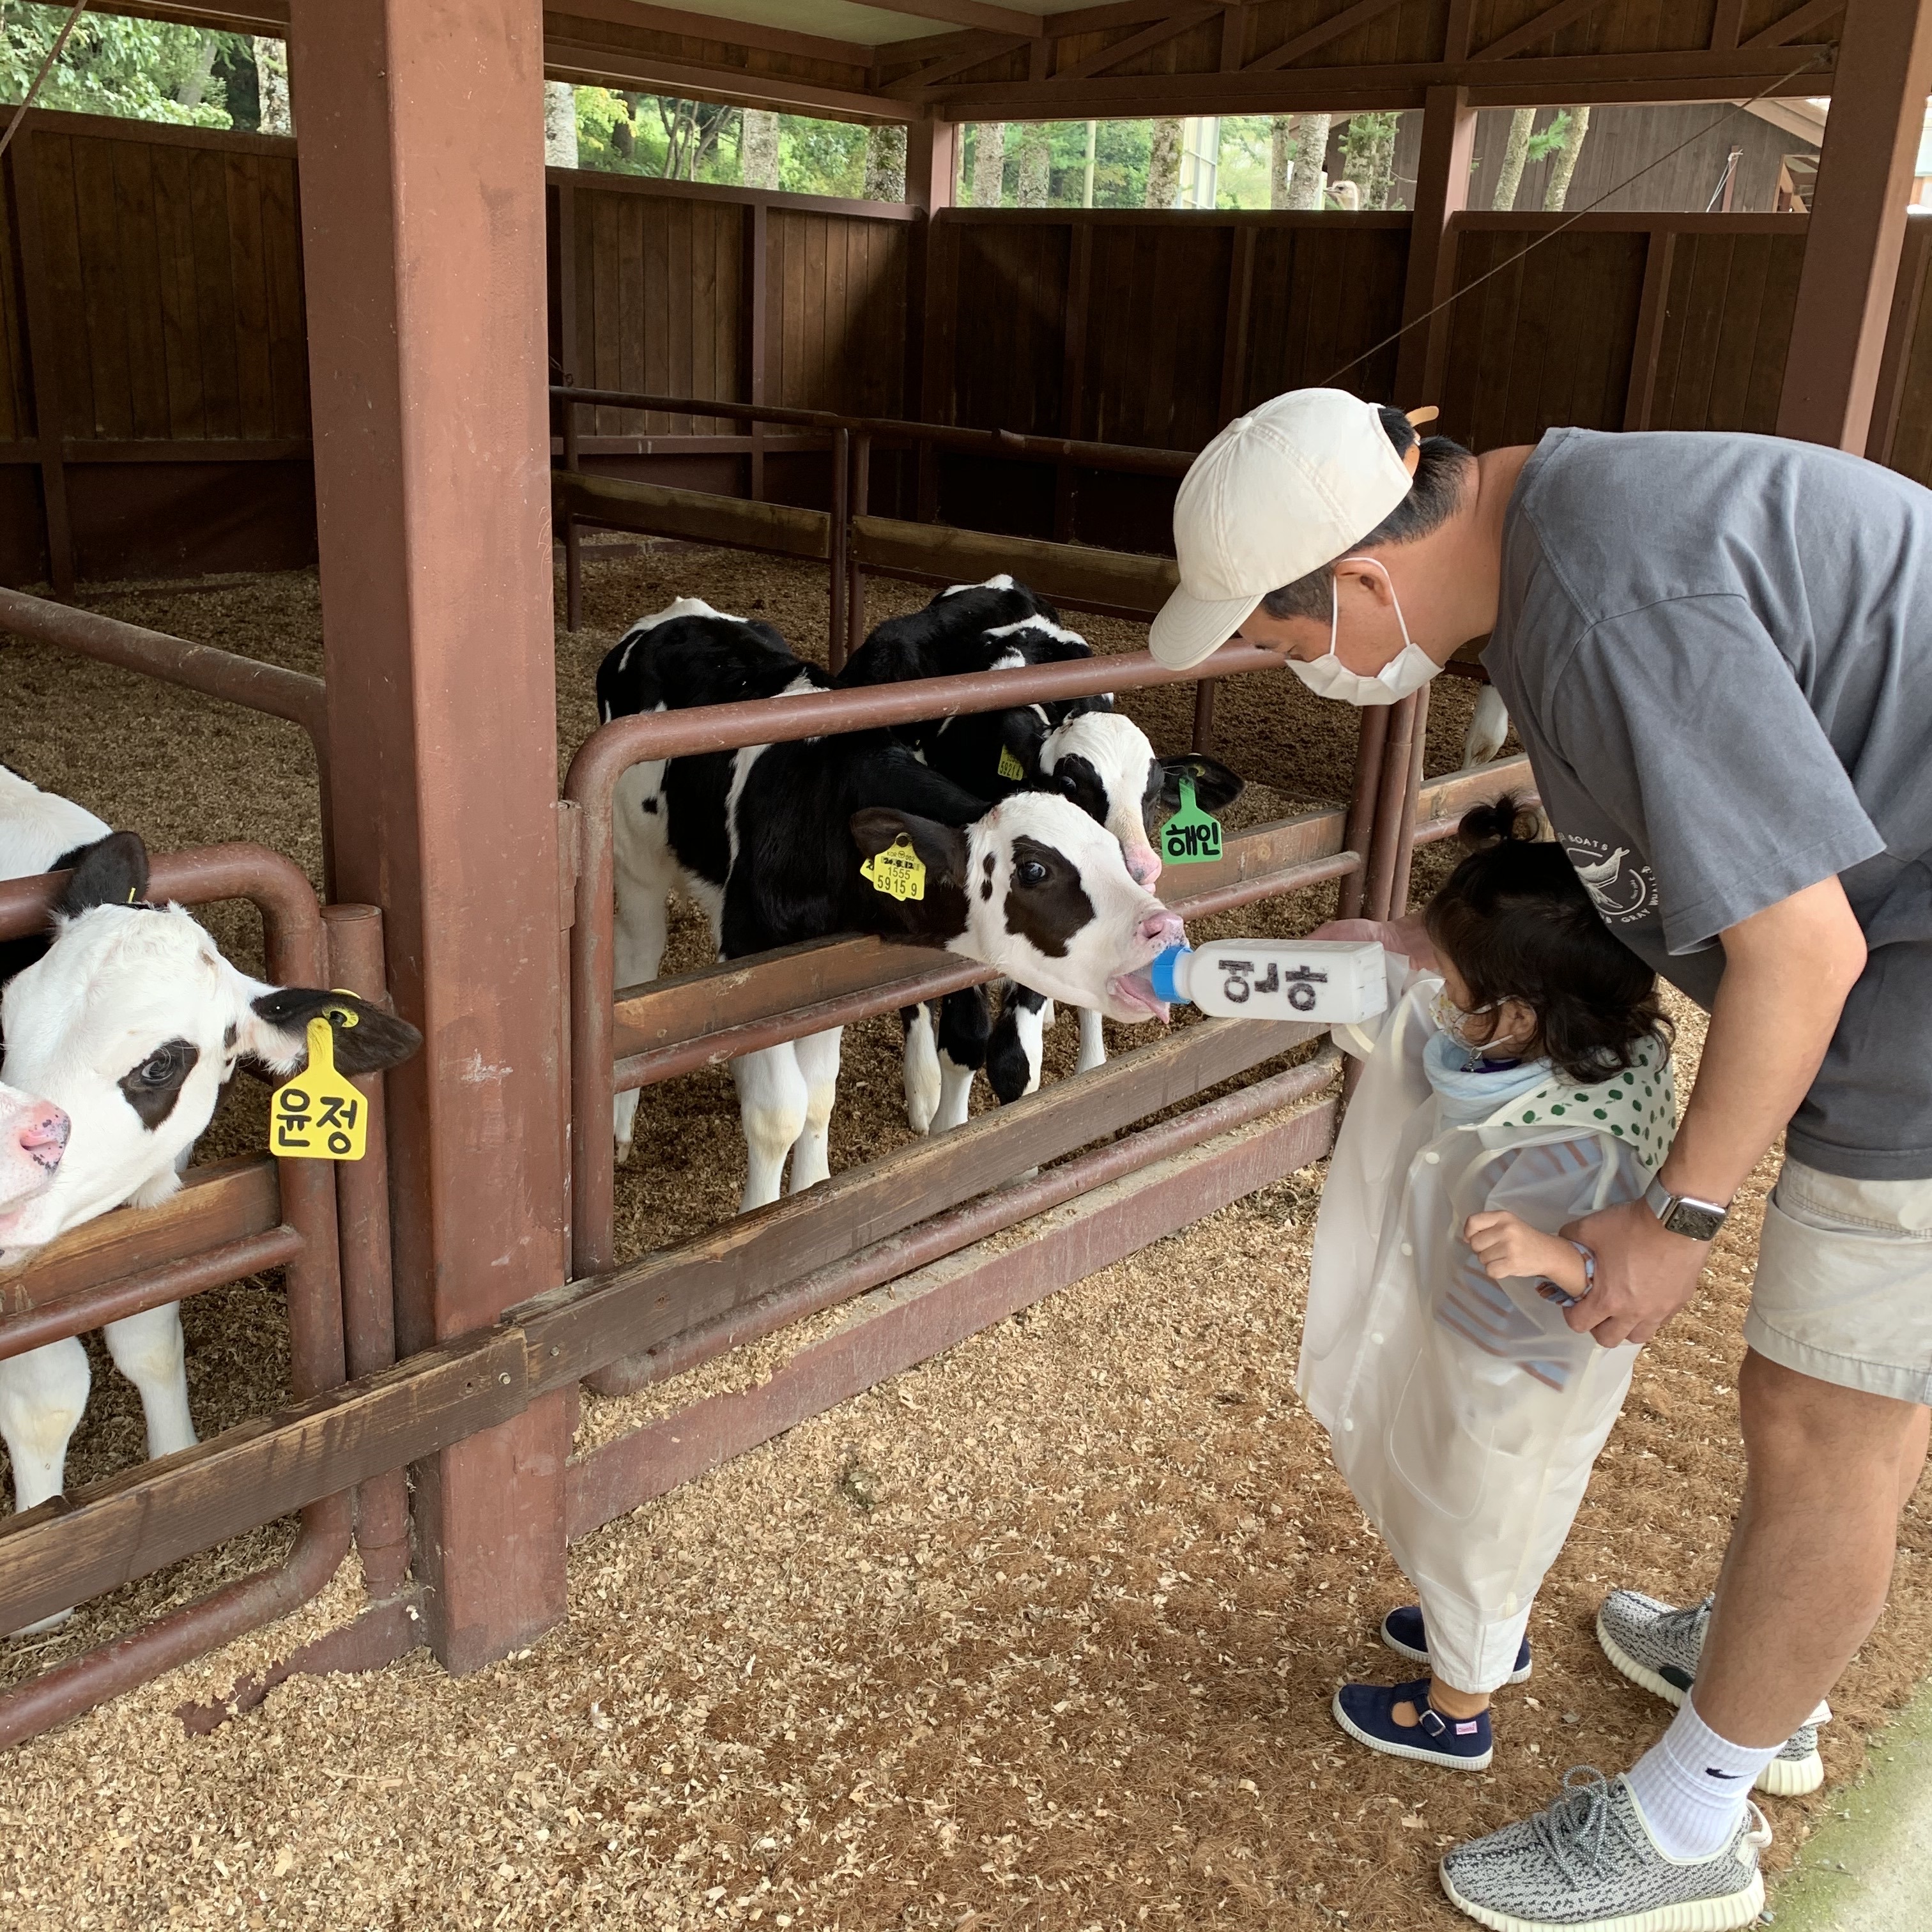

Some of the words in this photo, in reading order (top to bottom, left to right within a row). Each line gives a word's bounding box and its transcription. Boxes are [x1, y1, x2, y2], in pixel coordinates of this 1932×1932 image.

[1165, 822, 1220, 856] 해인
[888, 866, 910, 880] 1555
[1621, 908, 1650, 923] GRAY
[276, 1088, 357, 1154] 윤정
